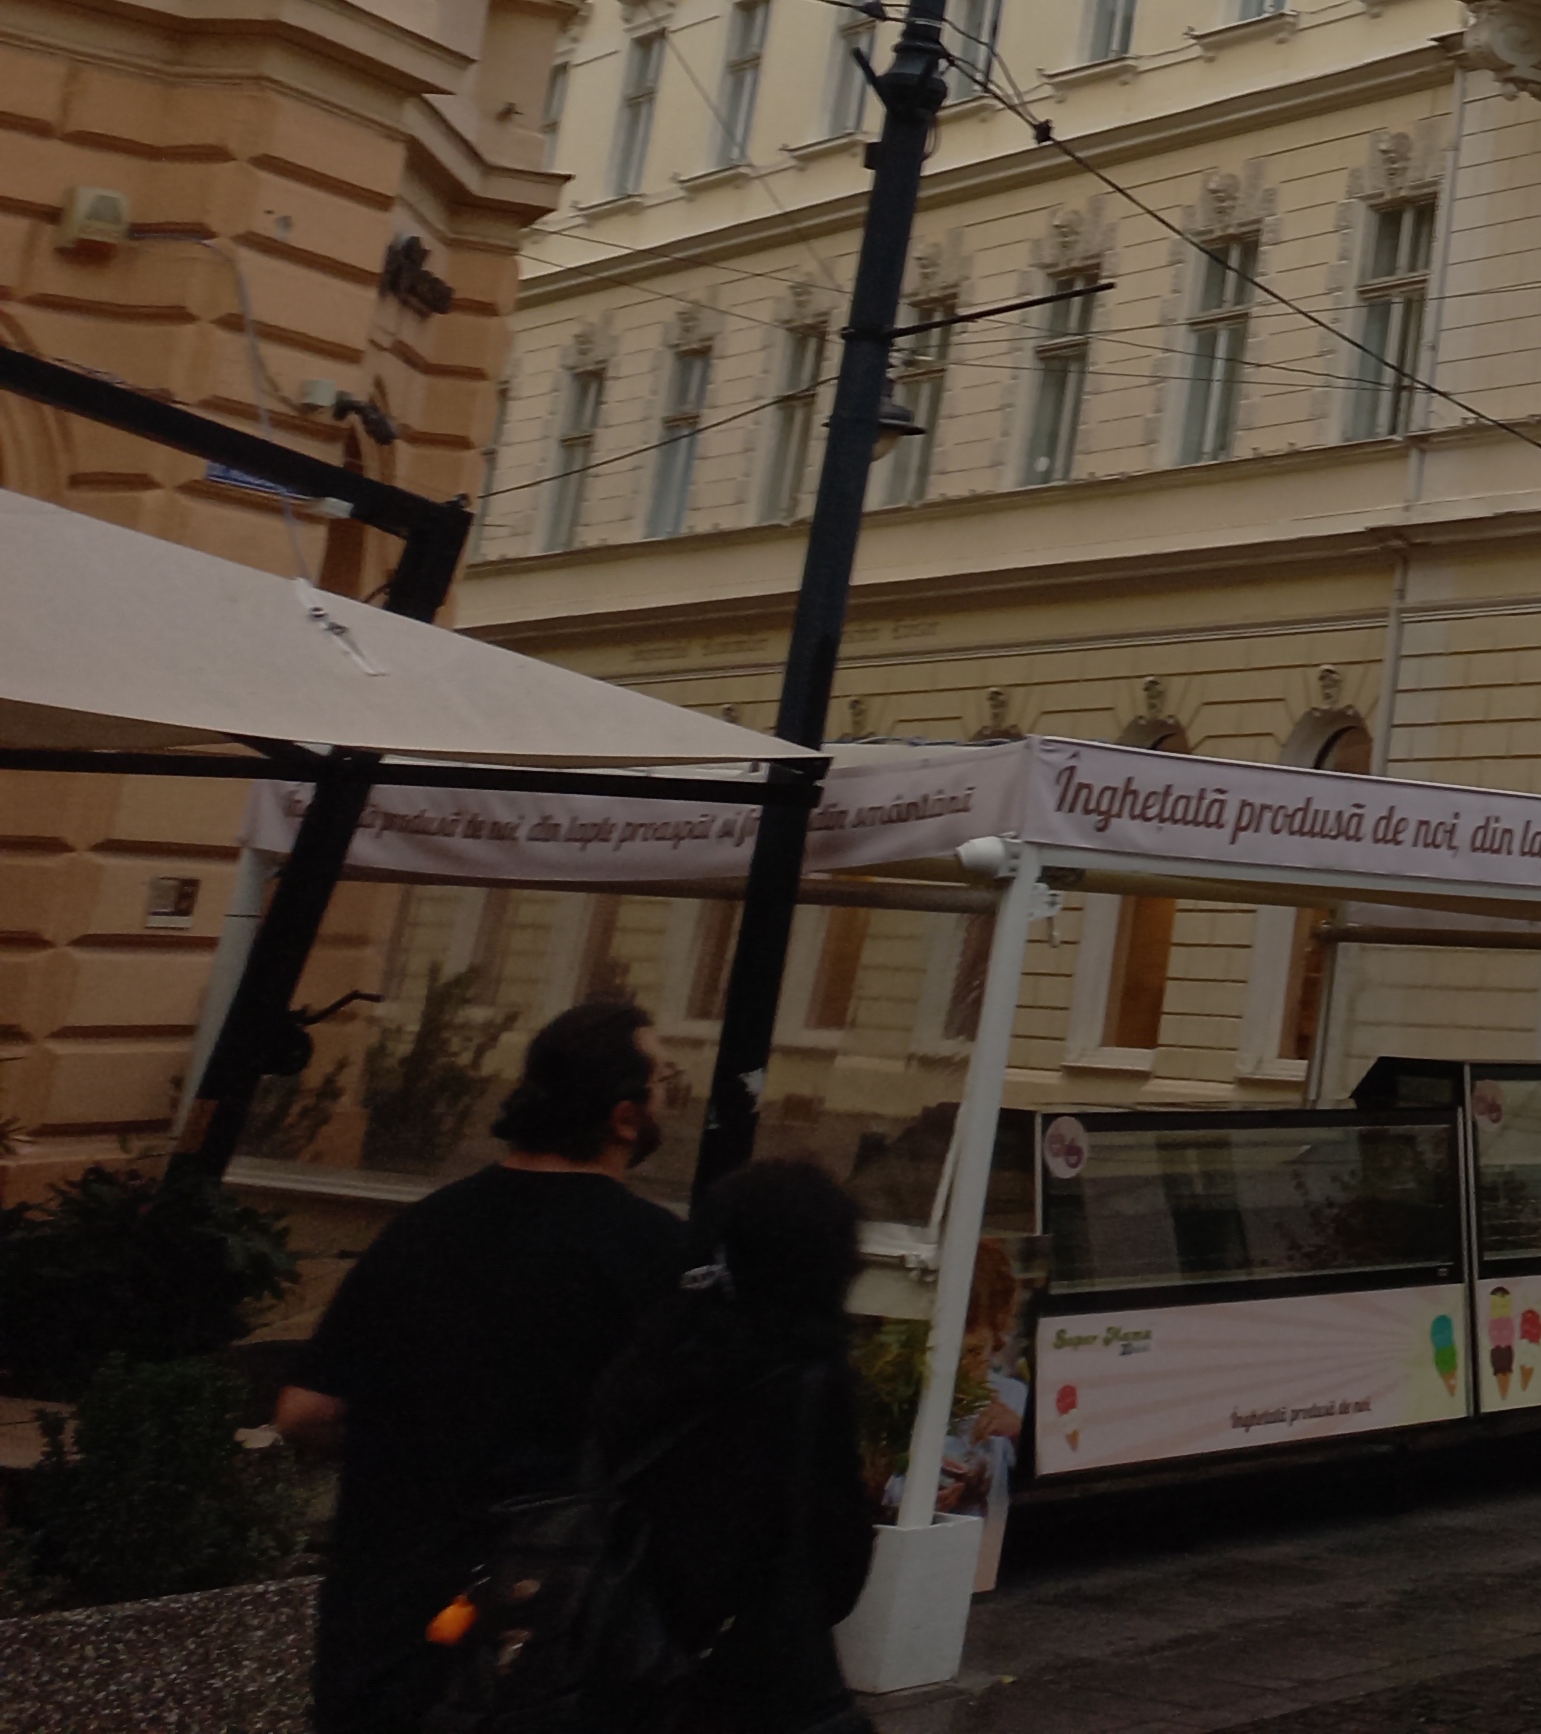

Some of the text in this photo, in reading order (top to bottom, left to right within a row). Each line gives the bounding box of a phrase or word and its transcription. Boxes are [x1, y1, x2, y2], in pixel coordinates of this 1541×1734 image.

[1228, 796, 1367, 846] produsă
[1372, 805, 1409, 846] de
[1470, 815, 1514, 856] din
